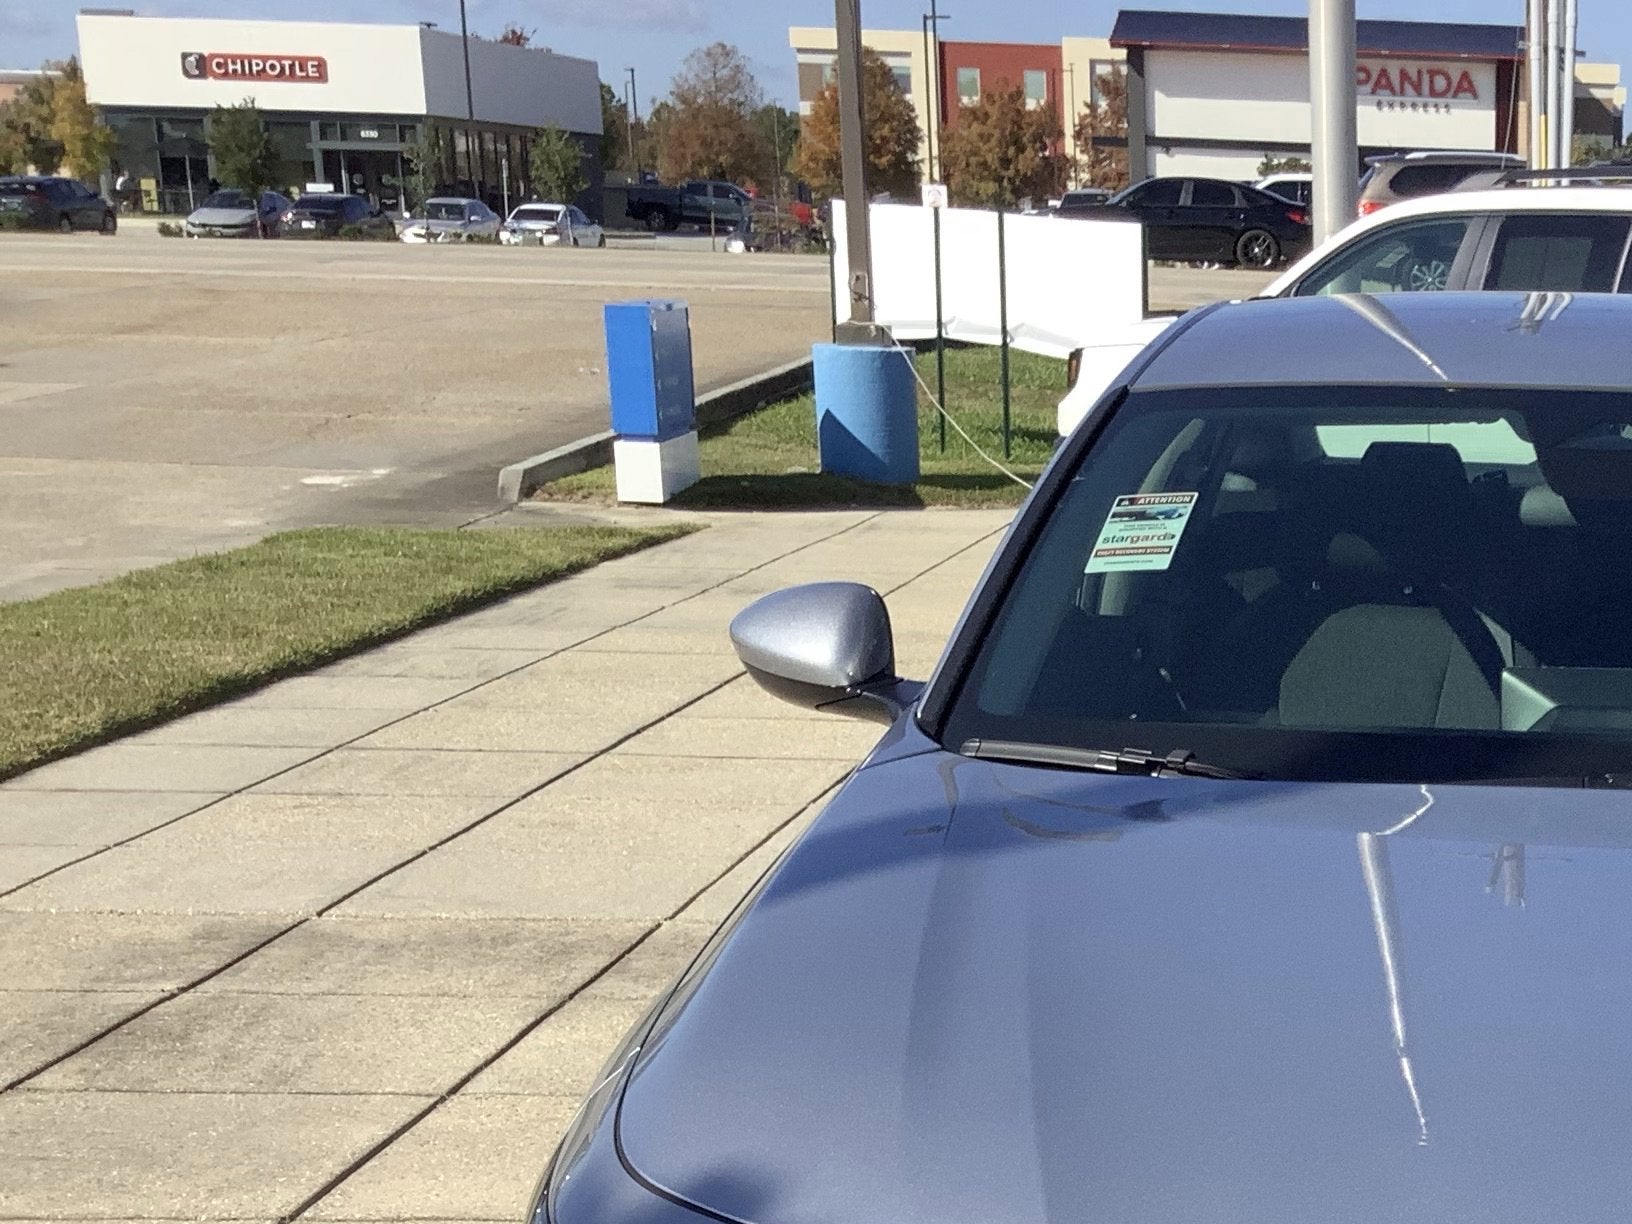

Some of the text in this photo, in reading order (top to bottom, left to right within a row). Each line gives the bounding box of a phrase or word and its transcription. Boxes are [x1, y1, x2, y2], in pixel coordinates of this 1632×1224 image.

[211, 57, 320, 77] CHIPOTLE
[1138, 496, 1191, 505] ATTENTION
[1103, 533, 1168, 544] stargard
